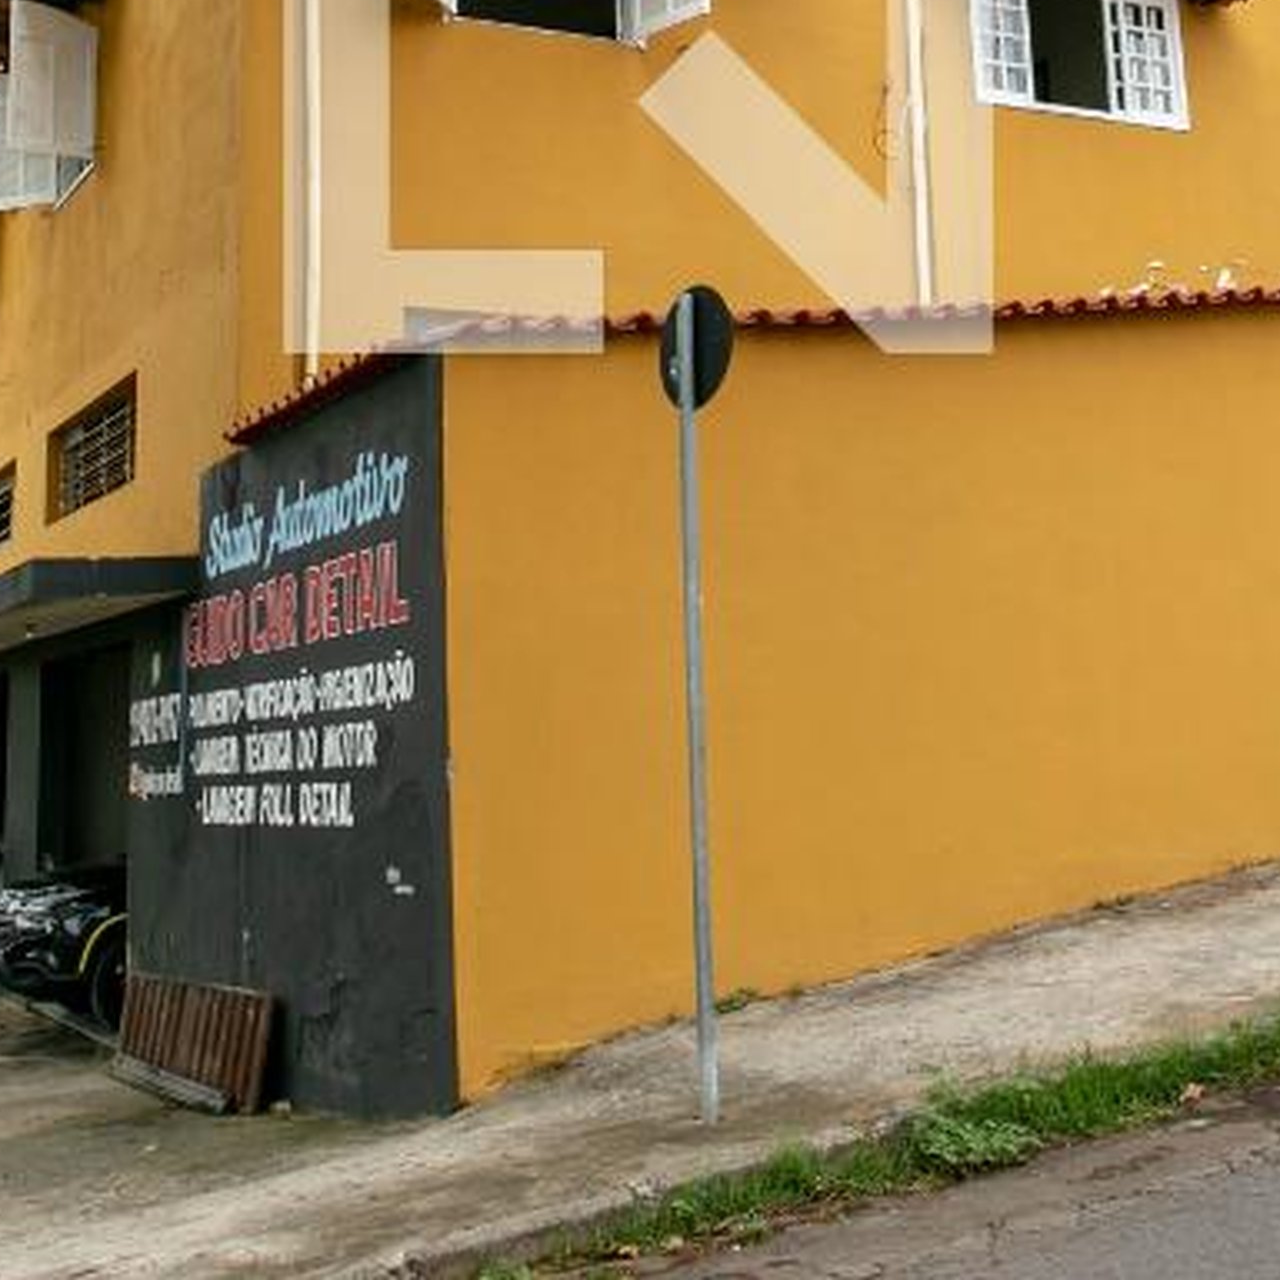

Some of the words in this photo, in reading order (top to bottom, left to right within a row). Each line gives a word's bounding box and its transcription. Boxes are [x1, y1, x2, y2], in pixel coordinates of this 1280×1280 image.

[205, 502, 264, 579] Studio
[264, 452, 409, 570] Automotivo
[248, 572, 299, 654] CAR
[305, 541, 410, 645] DETAIL
[297, 726, 318, 771] DO
[321, 720, 378, 771] MOTOR
[258, 782, 294, 828] FULL
[298, 781, 355, 827] DETAIL
